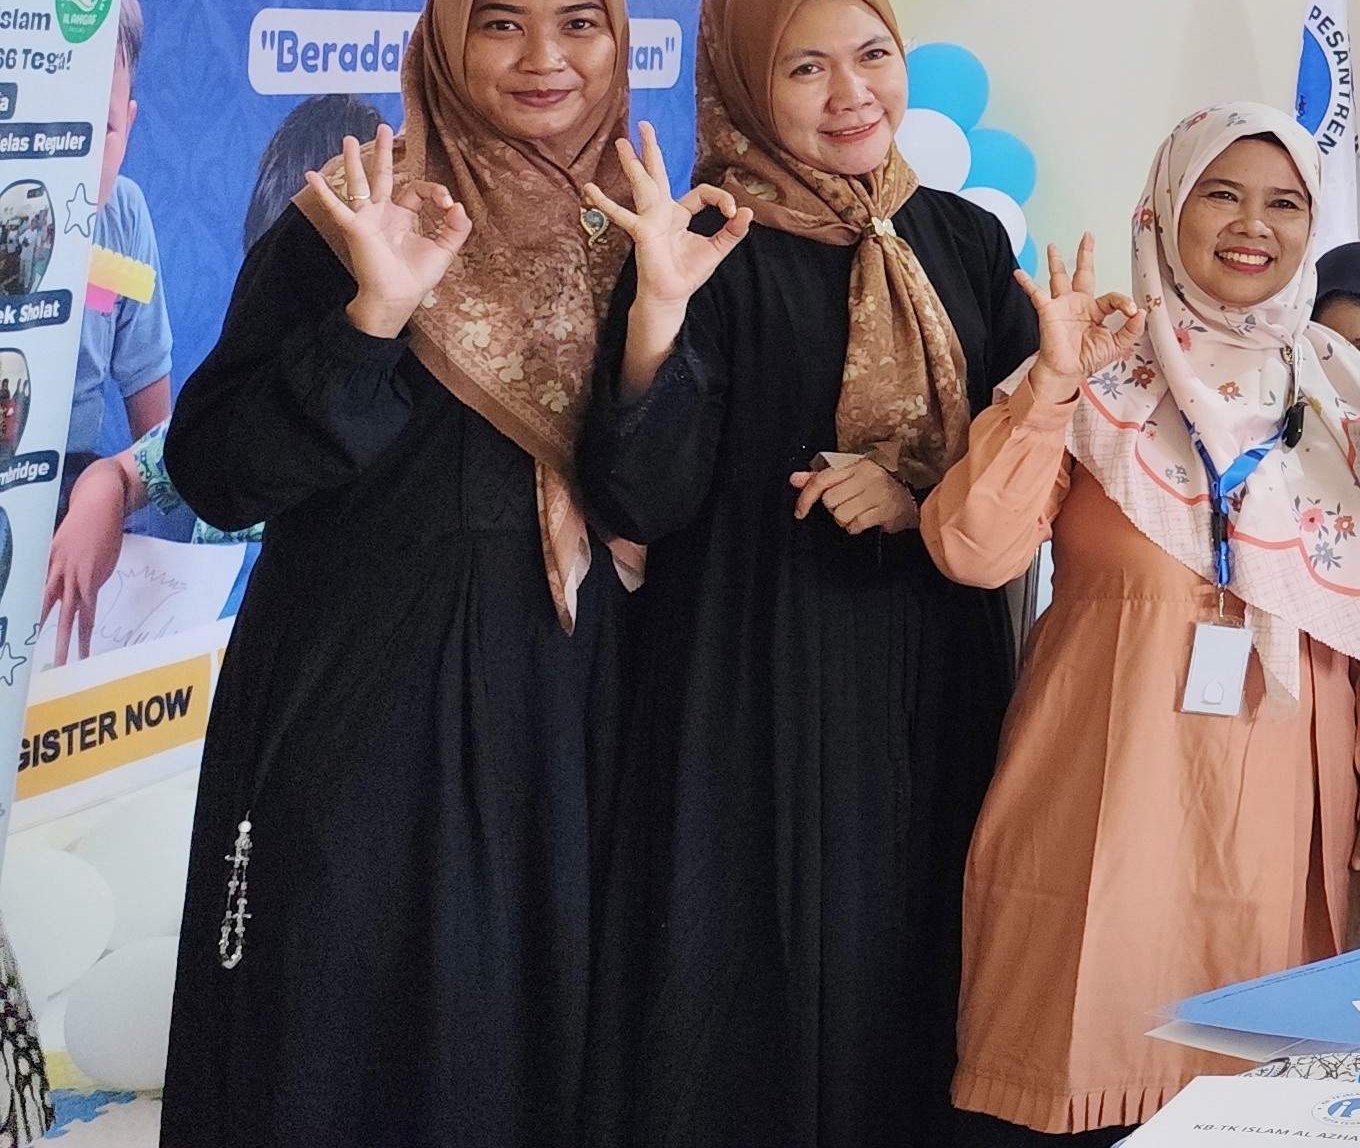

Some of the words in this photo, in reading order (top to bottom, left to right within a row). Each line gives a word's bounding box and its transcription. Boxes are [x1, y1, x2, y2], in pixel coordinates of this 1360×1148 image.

[0, 8, 51, 31] slam
[261, 29, 408, 74] "Berada
[1308, 4, 1351, 155] PESANTREN
[0, 132, 29, 152] elas
[19, 300, 60, 323] Sholat
[125, 685, 194, 736] NOW
[1241, 1126, 1291, 1136] ISLAM
[1292, 1130, 1312, 1138] AL
